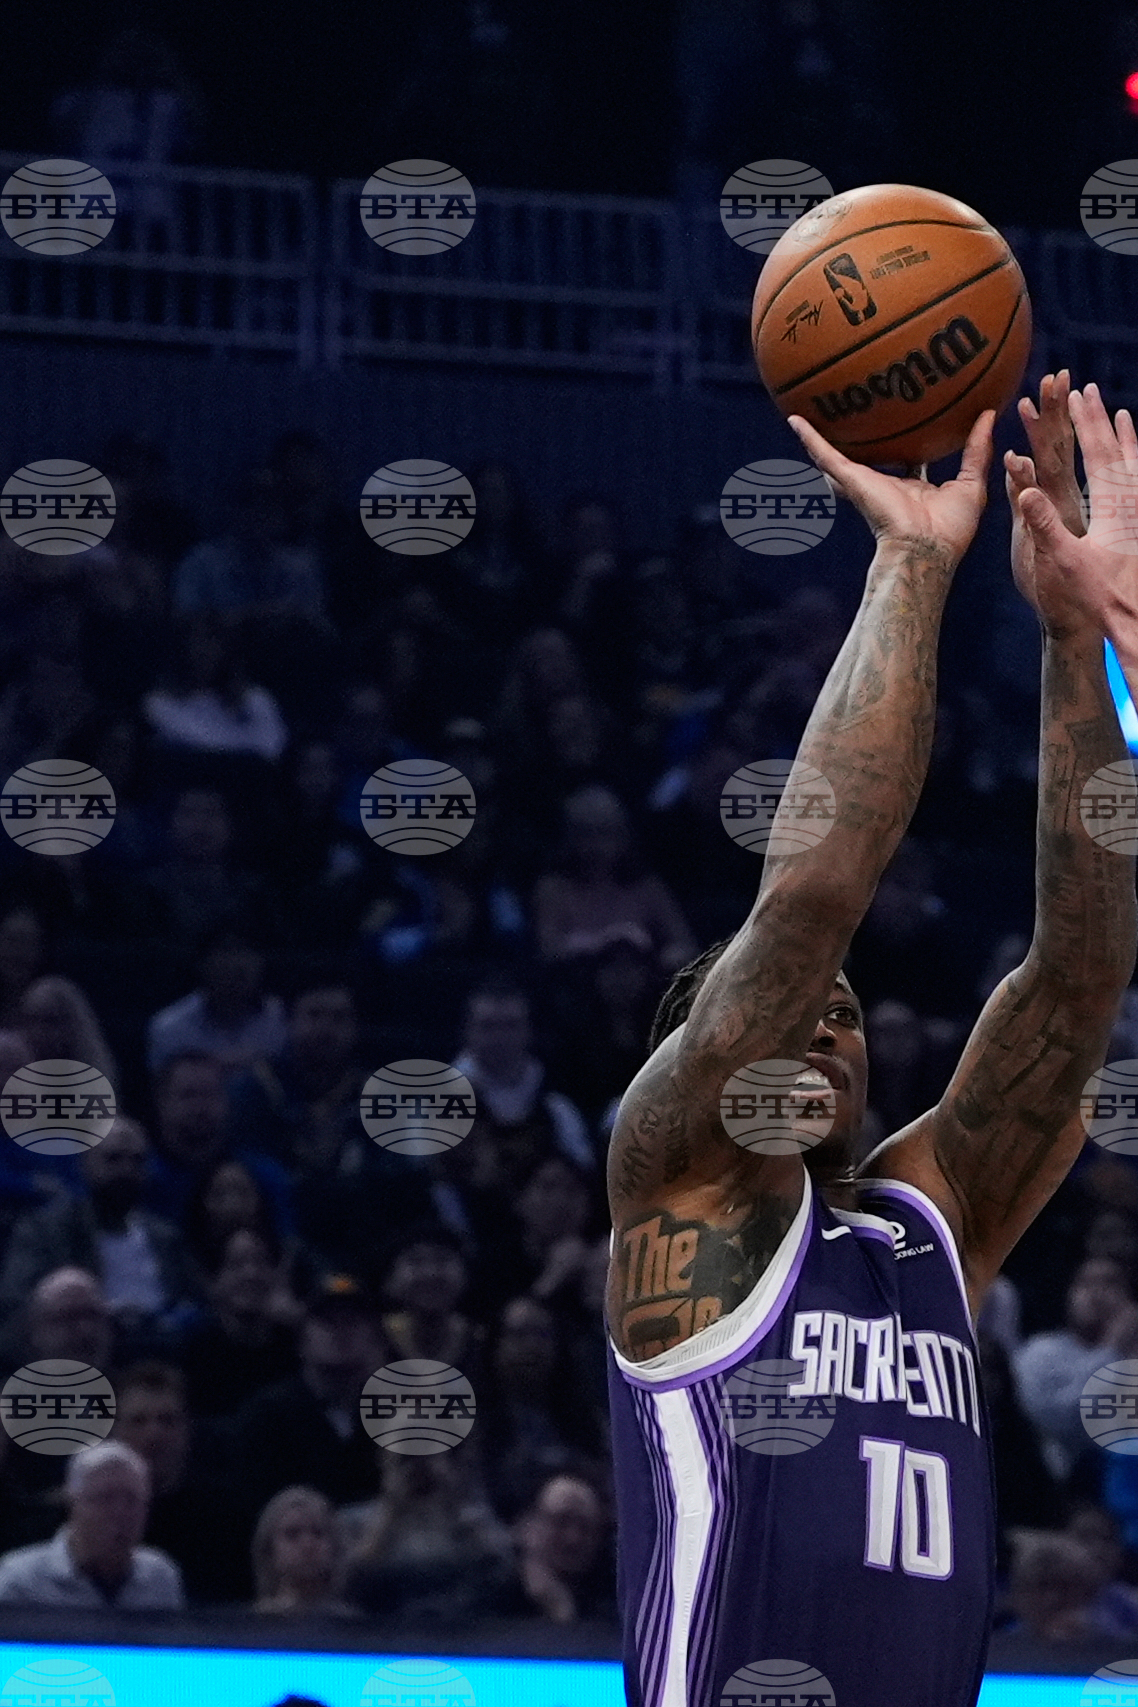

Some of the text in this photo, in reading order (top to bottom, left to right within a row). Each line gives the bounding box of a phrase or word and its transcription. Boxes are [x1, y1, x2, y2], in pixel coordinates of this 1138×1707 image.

[812, 314, 989, 422] Wilson
[623, 1216, 700, 1303] The
[859, 1435, 953, 1581] 10
